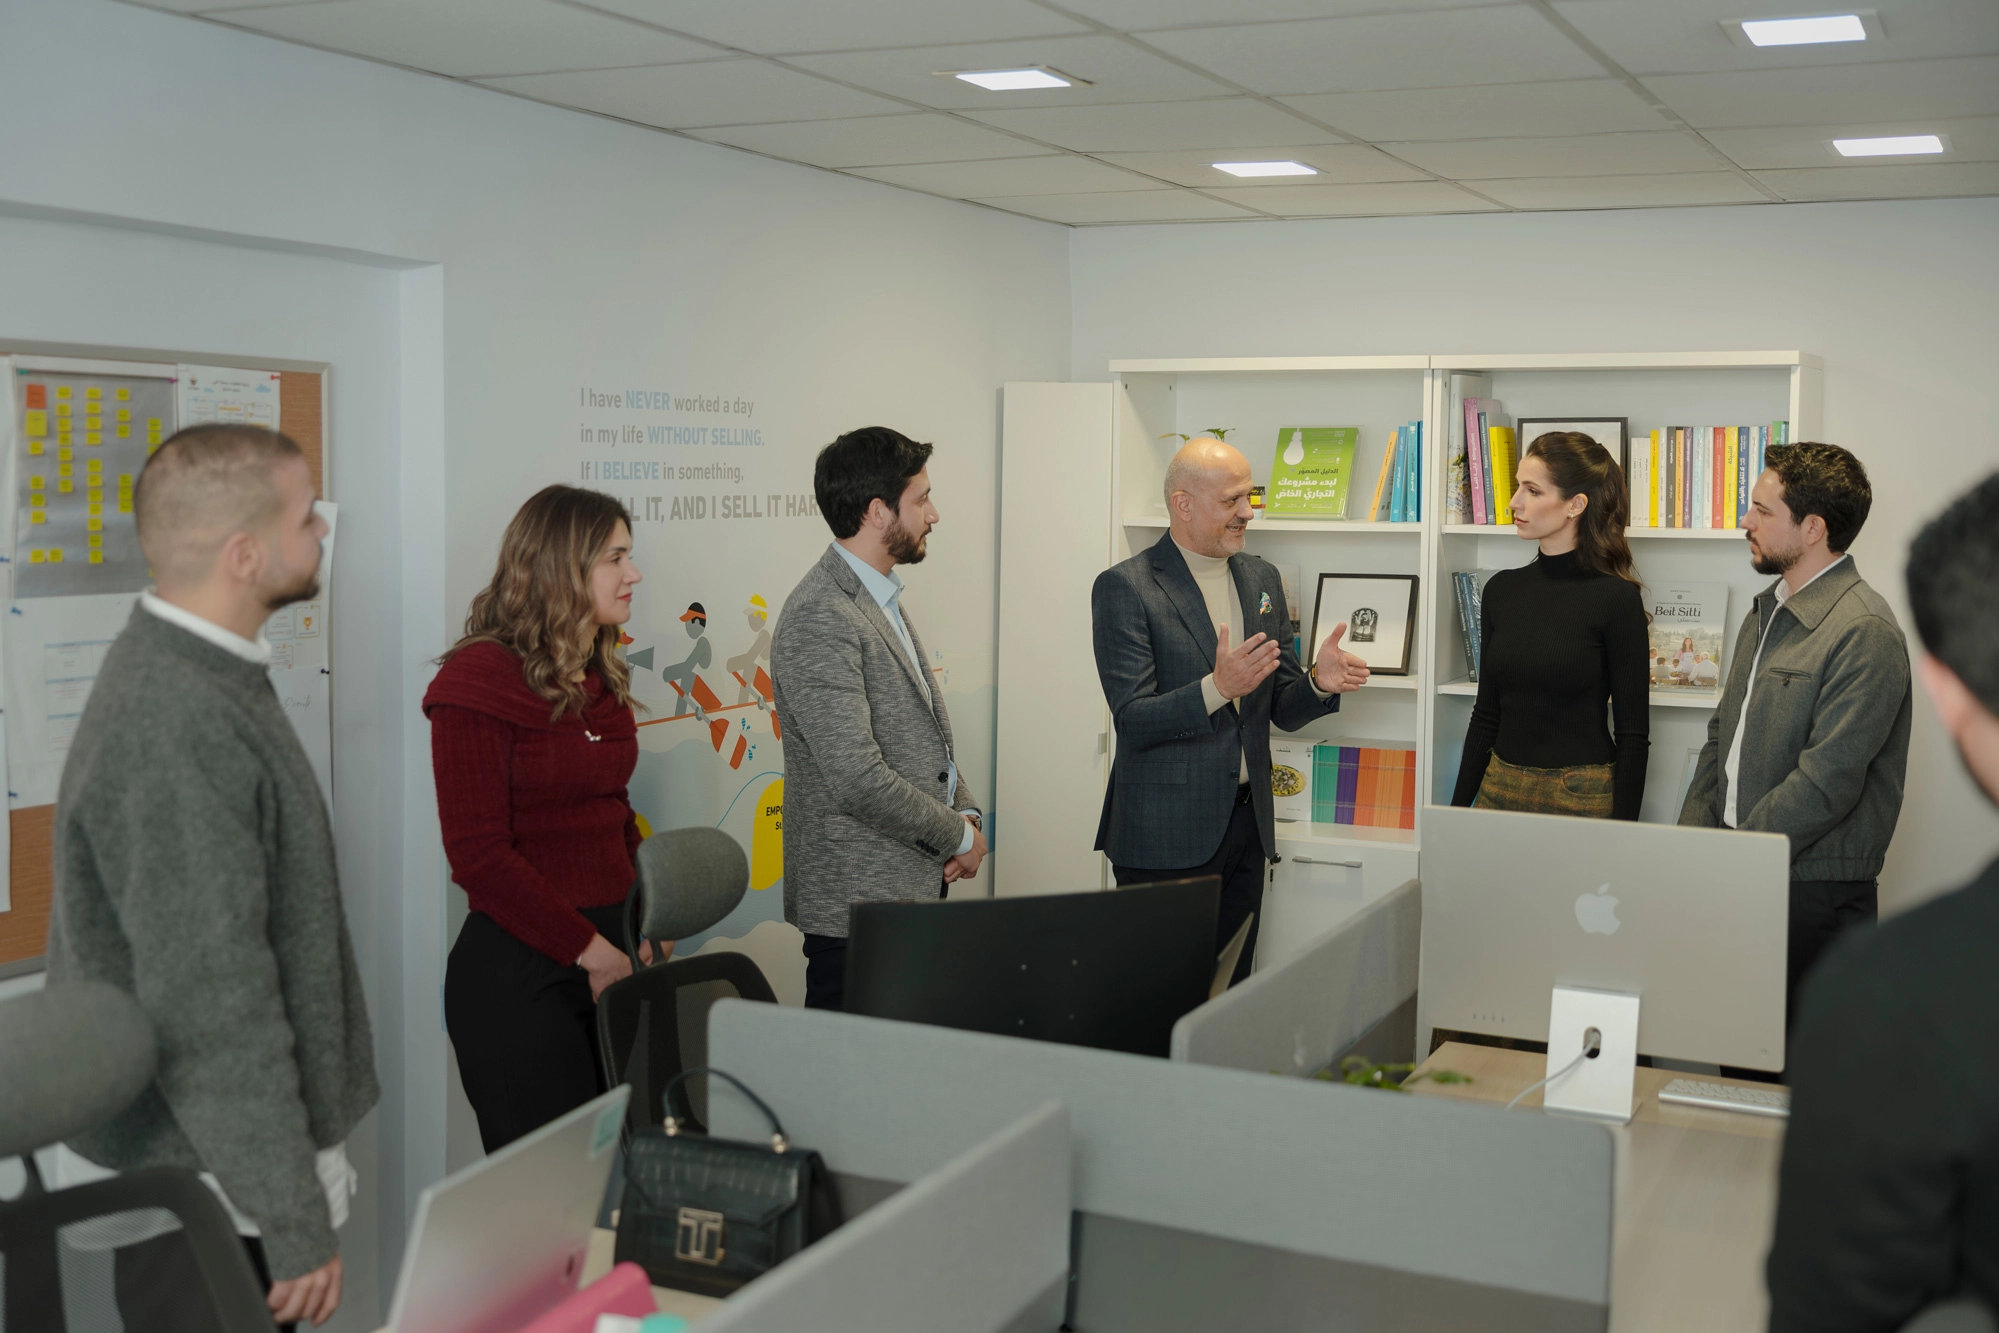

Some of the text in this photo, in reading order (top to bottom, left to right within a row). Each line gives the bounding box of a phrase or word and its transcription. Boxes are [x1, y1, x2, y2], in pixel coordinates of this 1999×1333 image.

[580, 388, 754, 418] I have NEVER worked a day
[580, 424, 765, 447] in my life WITHOUT SELLING.
[580, 461, 744, 484] If I BELIEVE in something,
[645, 496, 665, 524] IT,
[670, 495, 707, 520] AND
[711, 496, 716, 520] I
[721, 495, 762, 519] SELL
[766, 494, 782, 518] IT
[785, 494, 824, 517] HAR
[1654, 606, 1701, 617] Beit Sitti
